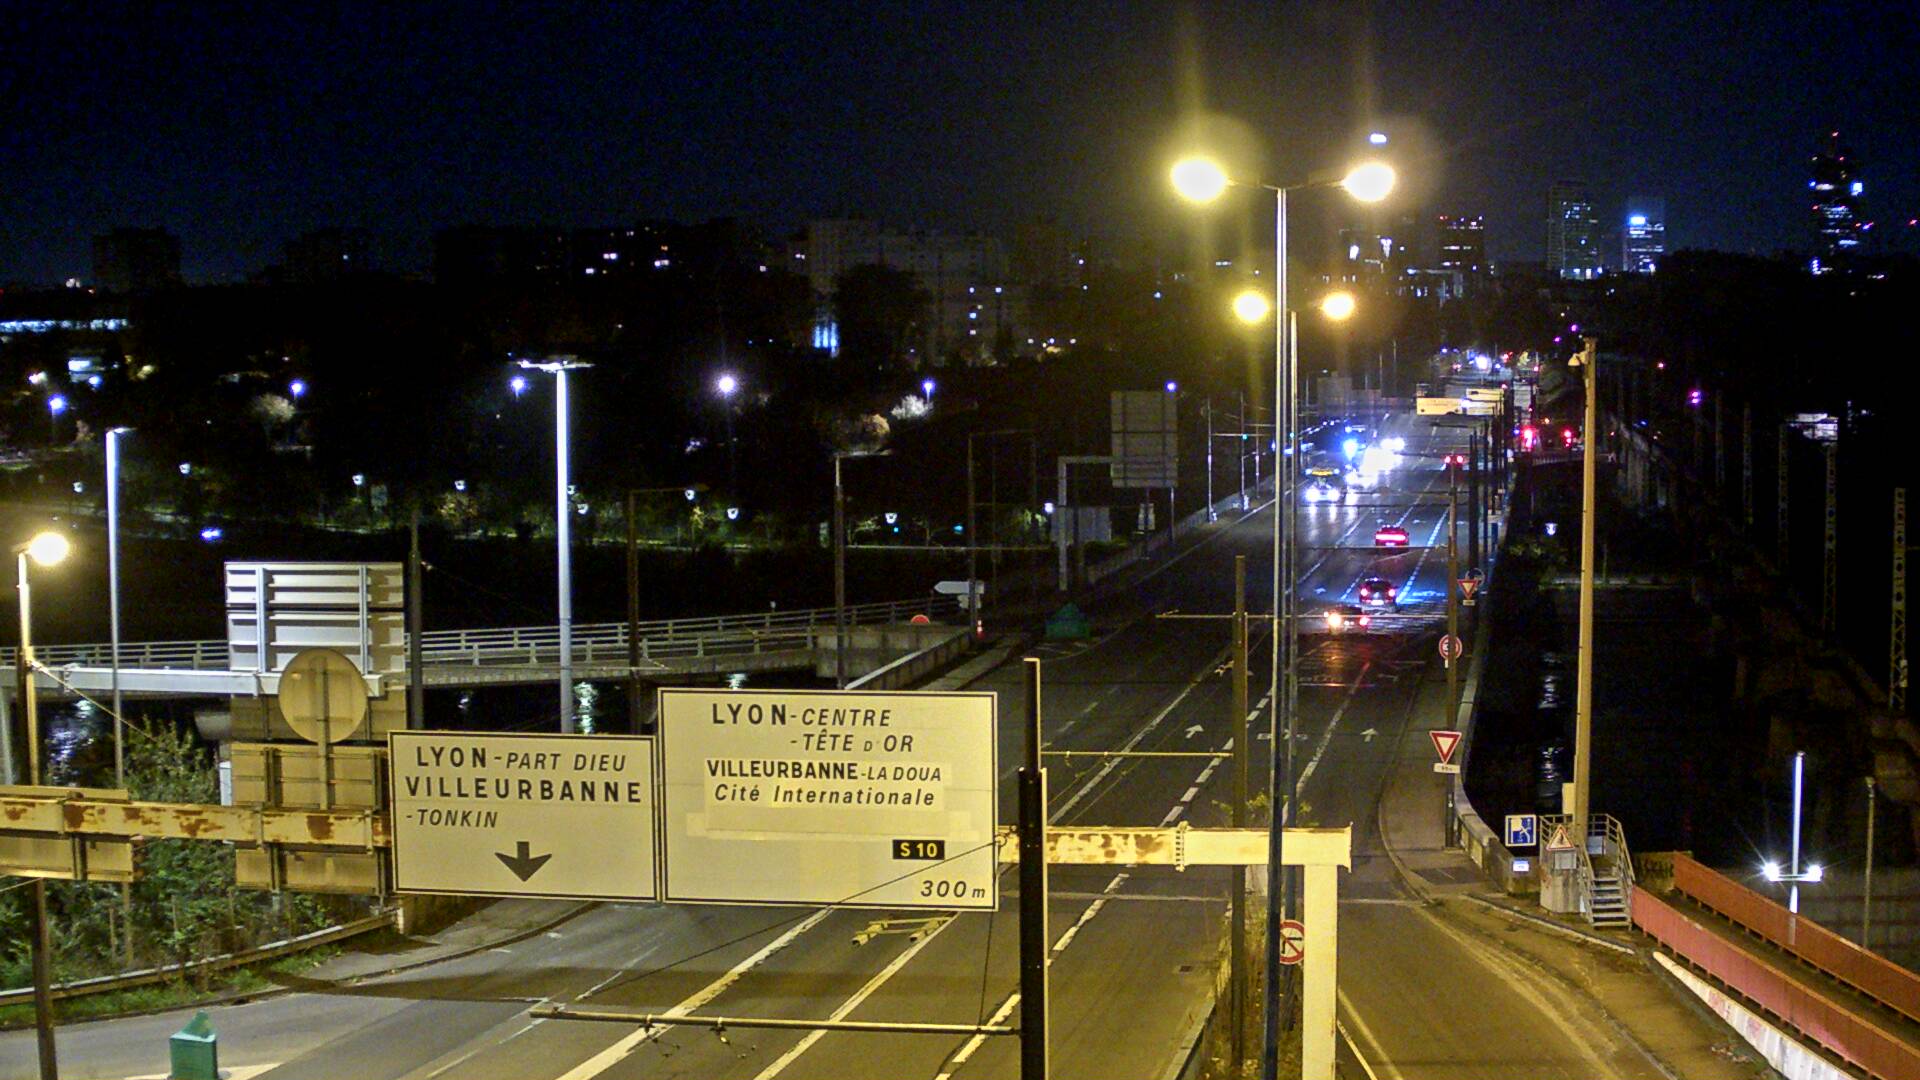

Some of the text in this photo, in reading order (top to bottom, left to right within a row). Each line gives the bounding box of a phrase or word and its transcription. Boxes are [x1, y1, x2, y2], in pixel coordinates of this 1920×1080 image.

[574, 754, 626, 772] DIEU
[893, 766, 941, 782] DOUA
[405, 776, 641, 803] VILLEURBANNE
[714, 783, 935, 806] Cité Internationale
[920, 880, 967, 898] 300
